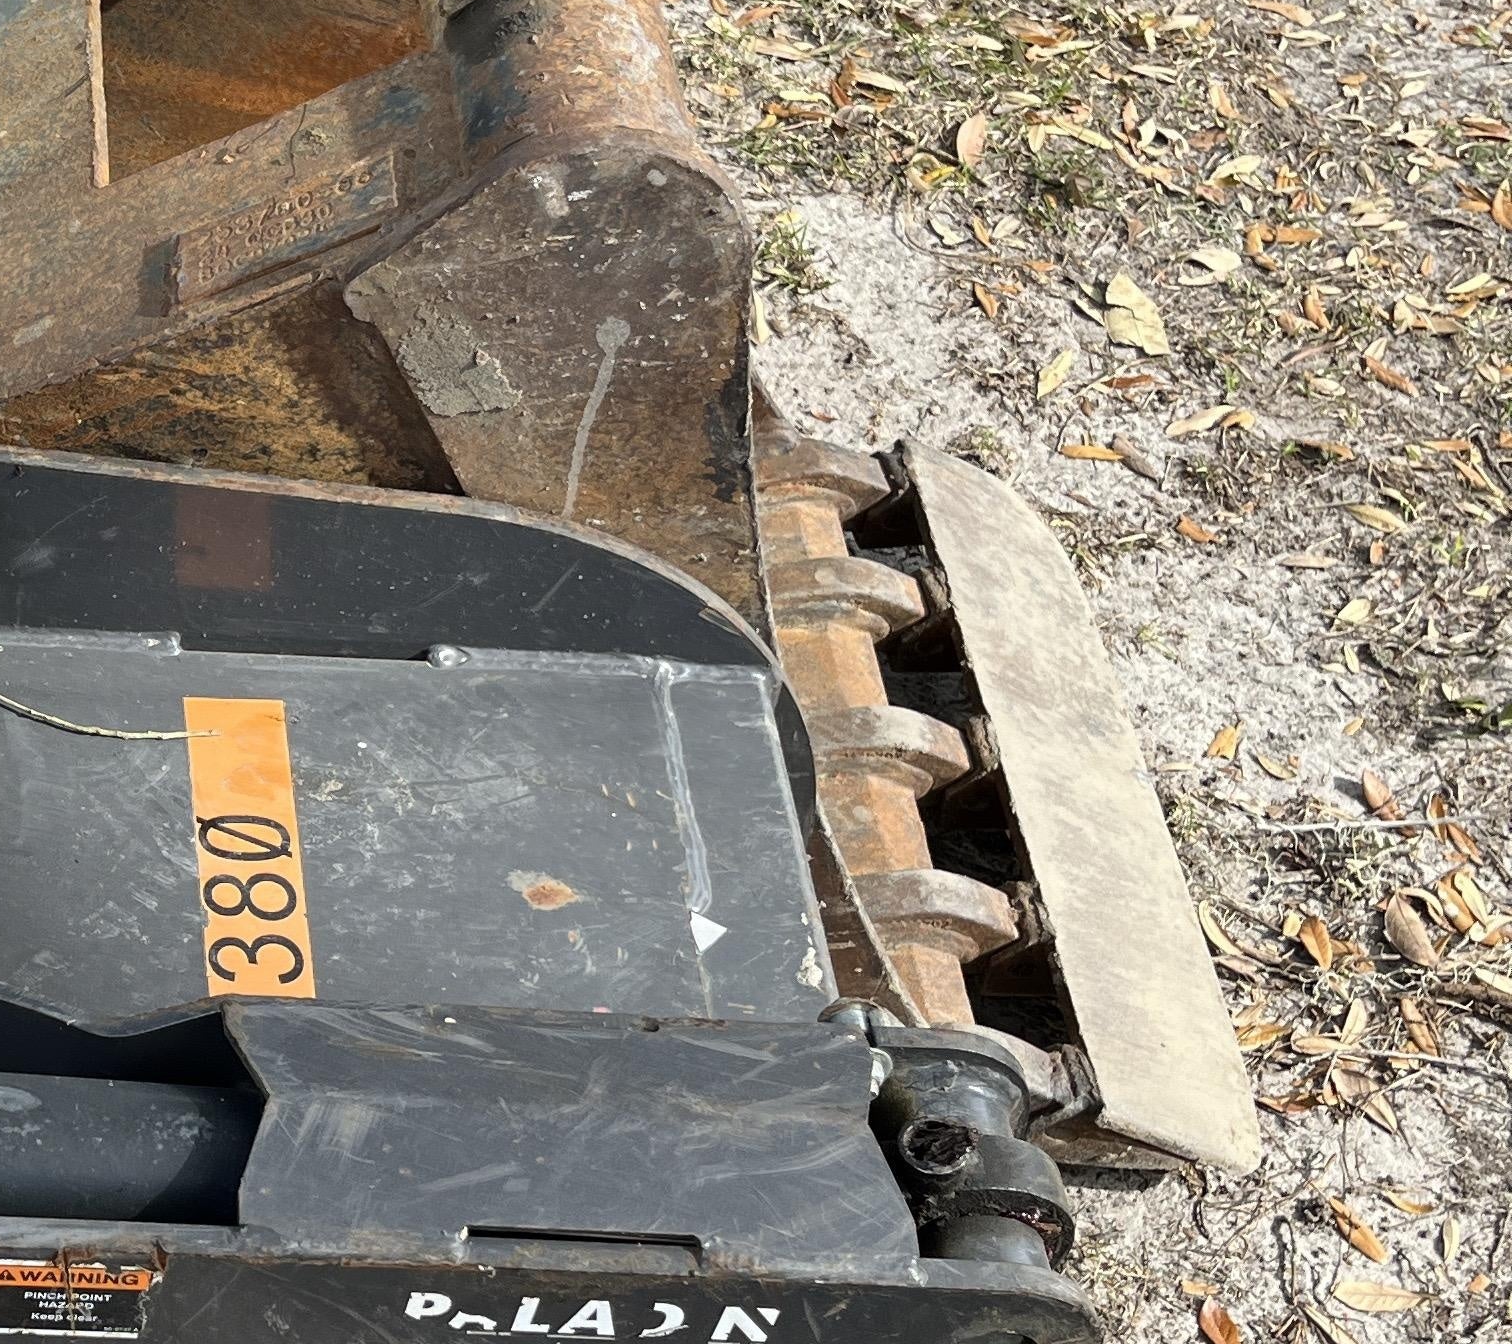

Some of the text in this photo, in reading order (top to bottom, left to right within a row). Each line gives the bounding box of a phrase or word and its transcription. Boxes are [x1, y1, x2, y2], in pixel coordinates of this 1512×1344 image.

[194, 814, 305, 985] 380
[19, 1269, 140, 1287] WARNING
[23, 1290, 113, 1303] PINCH POINT
[38, 1300, 95, 1310] HAZARD
[30, 1311, 64, 1323] Keep
